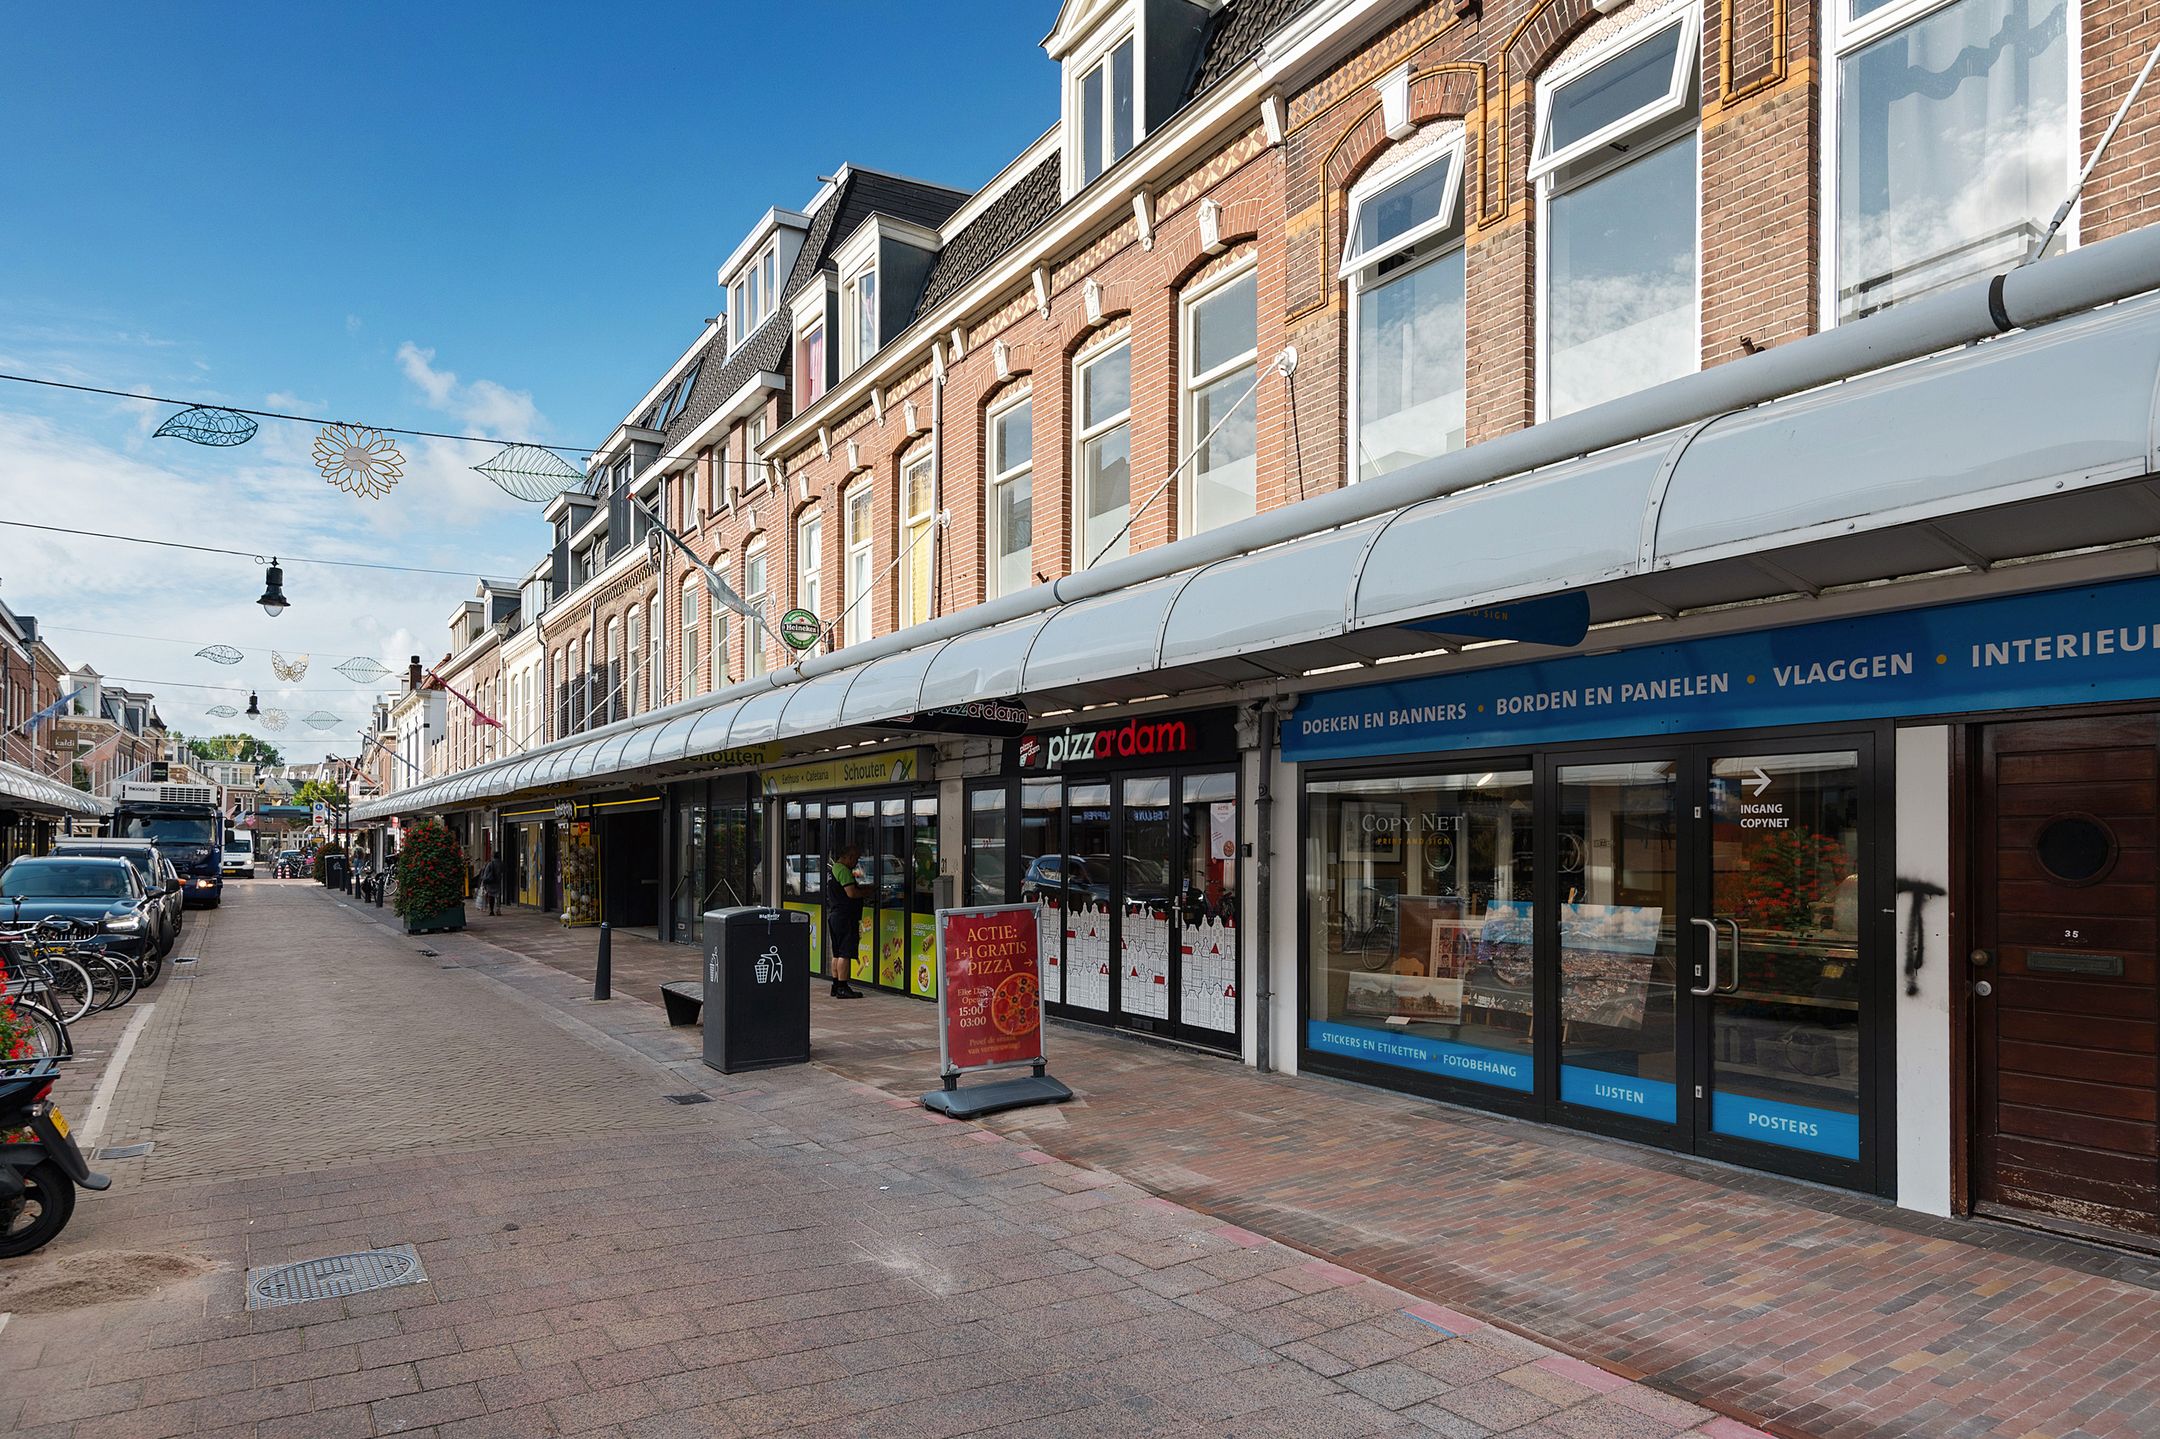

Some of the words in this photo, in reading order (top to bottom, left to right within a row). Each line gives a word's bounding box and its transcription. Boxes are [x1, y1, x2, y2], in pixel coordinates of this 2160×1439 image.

[786, 623, 817, 633] Heineken
[1772, 651, 1913, 687] VLAGGEN
[1496, 689, 1577, 716] BORDEN
[1584, 686, 1612, 706] EN
[1620, 672, 1729, 703] PANELEN
[1302, 714, 1359, 735] DOEKEN
[1364, 711, 1384, 729] EN
[1389, 702, 1467, 726] BANNERS
[843, 762, 886, 783] Schouten
[1740, 803, 1783, 814] INGANG
[1361, 813, 1416, 832] COPY
[1421, 812, 1464, 832] NET
[1740, 817, 1790, 828] COPYNET
[967, 925, 1018, 942] ACTIE:
[2064, 929, 2080, 939] 35
[954, 946, 974, 960] 1+1
[976, 940, 1027, 958] GRATIS
[967, 958, 1014, 976] PIZZA
[958, 1005, 984, 1017] 15:00
[959, 1015, 987, 1028] 03:00
[967, 1047, 980, 1055] van
[1321, 1032, 1361, 1048] STICKERS
[1363, 1039, 1375, 1051] EN
[1377, 1042, 1427, 1061] ETIKETTEN
[1443, 1054, 1517, 1078] FOTOBEHANG
[1595, 1083, 1644, 1105] LIJSTEN
[1748, 1111, 1819, 1138] POSTERS
